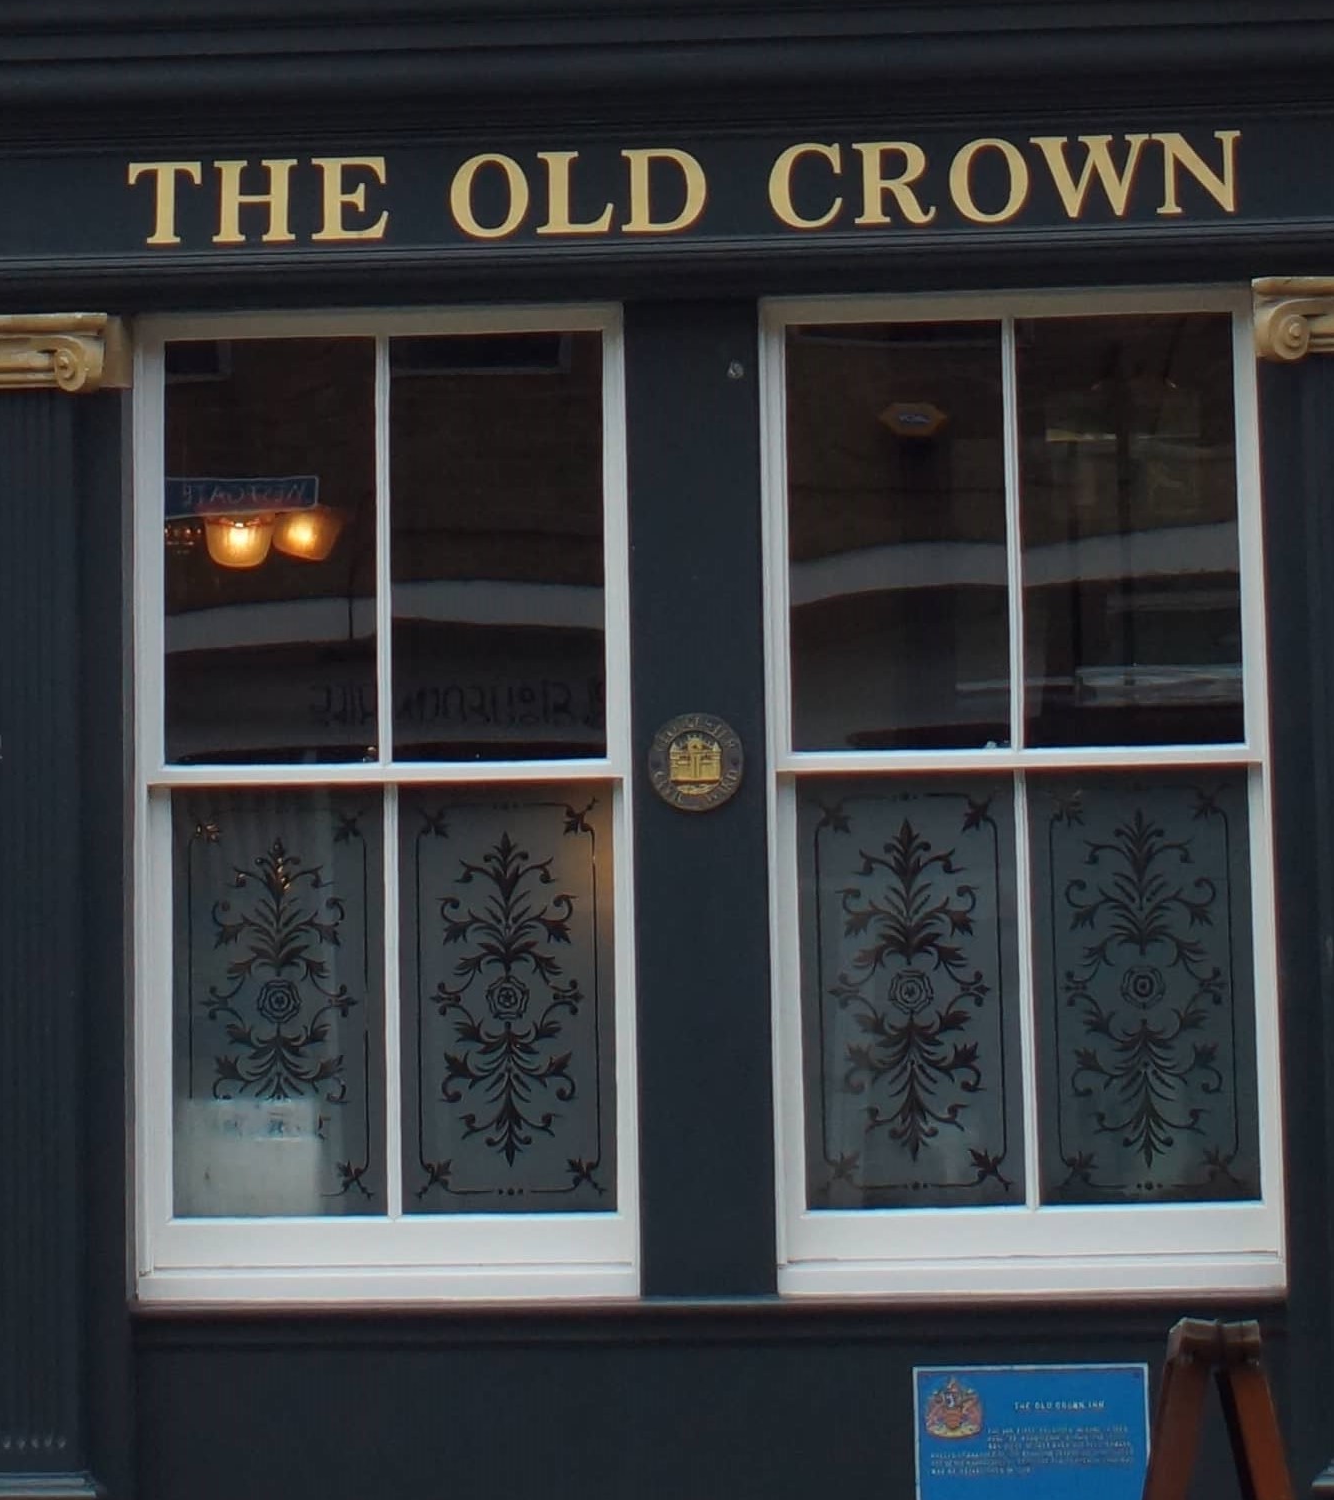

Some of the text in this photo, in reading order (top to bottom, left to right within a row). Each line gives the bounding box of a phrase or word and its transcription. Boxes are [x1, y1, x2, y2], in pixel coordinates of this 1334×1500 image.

[127, 129, 1242, 244] THE OLD CROWN
